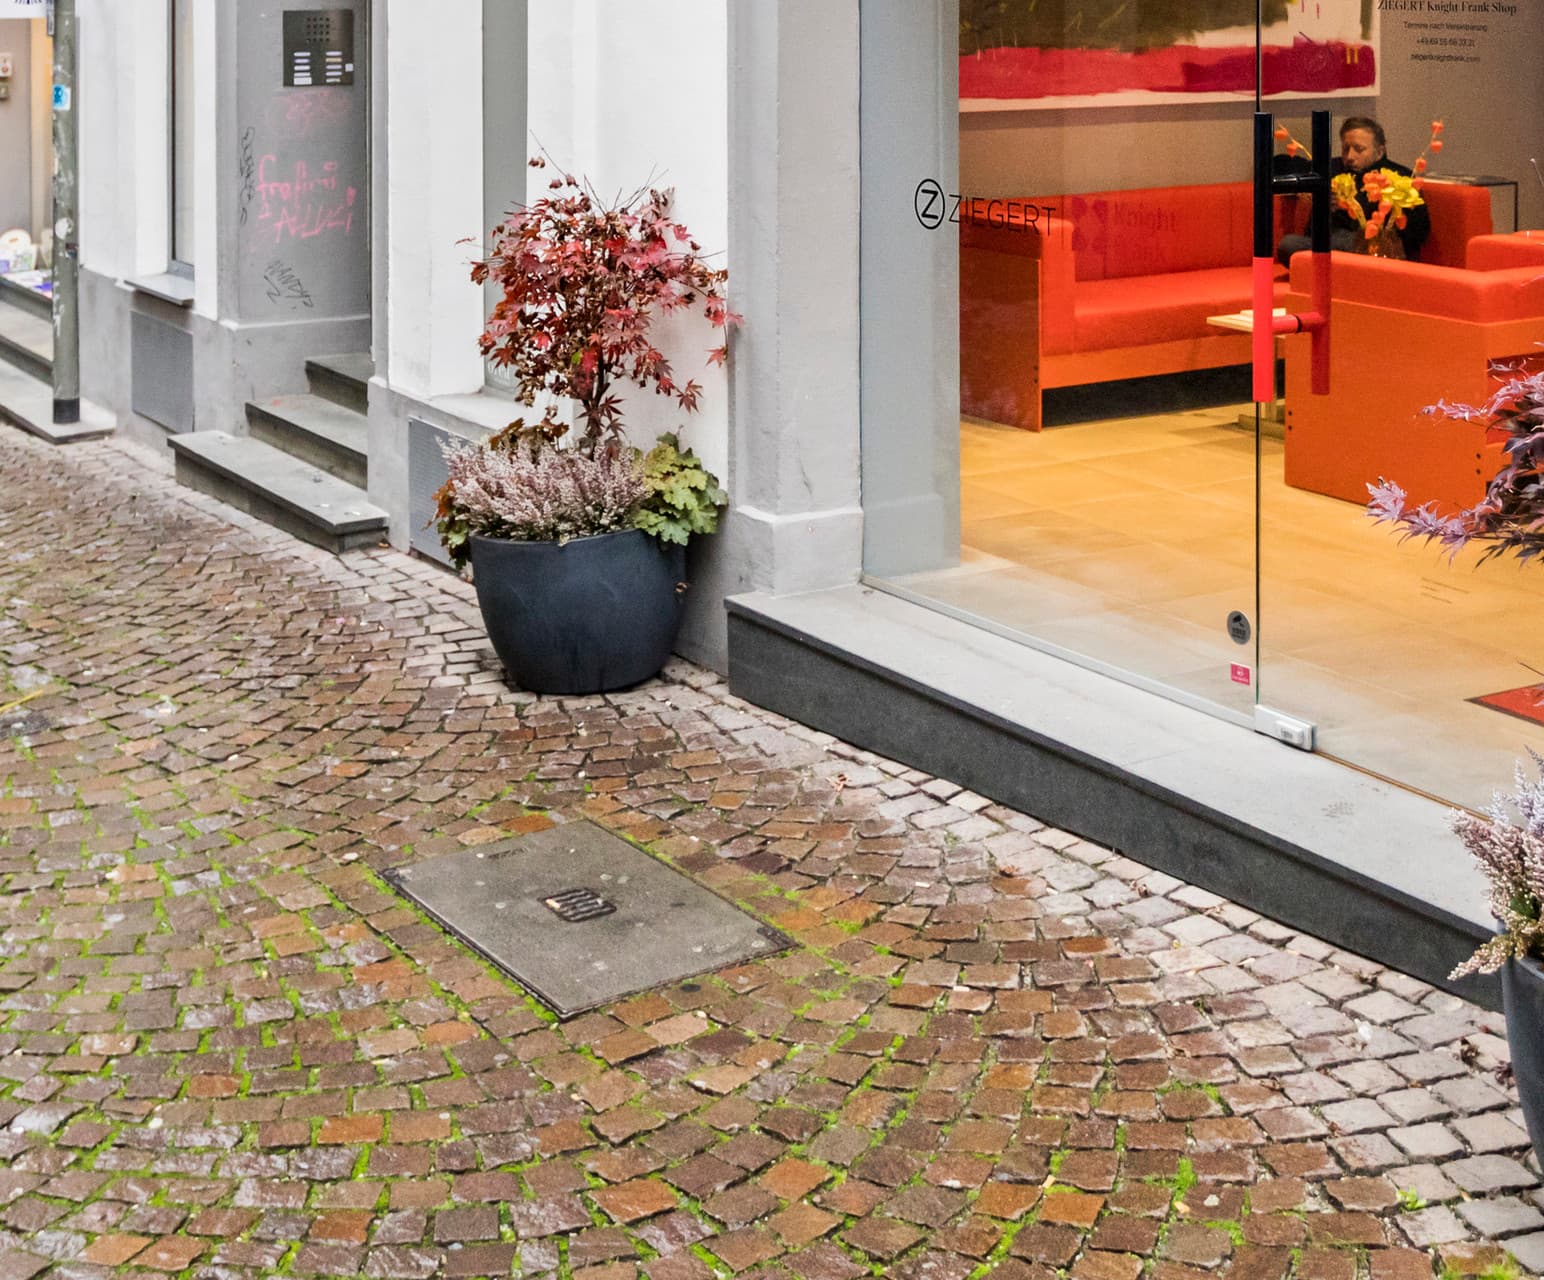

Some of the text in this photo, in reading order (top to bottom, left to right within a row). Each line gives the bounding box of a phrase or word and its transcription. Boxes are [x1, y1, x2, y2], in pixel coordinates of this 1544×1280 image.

[1377, 0, 1517, 16] ZIEGERT Knight Frank Shop
[1429, 22, 1445, 31] nach
[948, 194, 1057, 236] ZIEGERT
[1114, 200, 1176, 236] Knight
